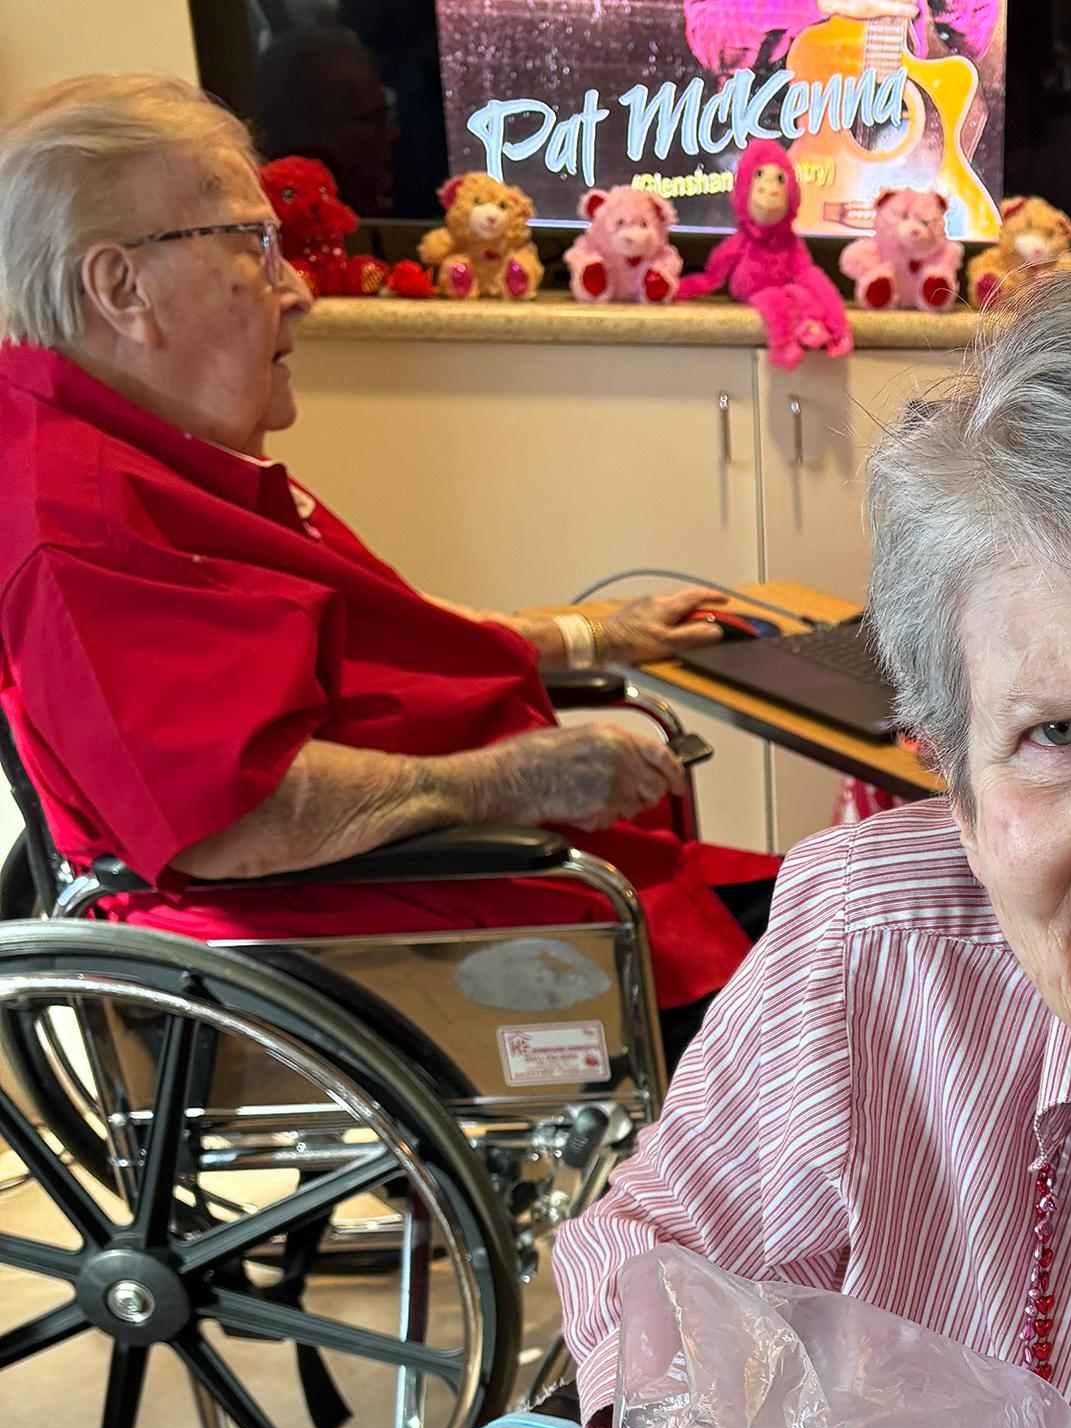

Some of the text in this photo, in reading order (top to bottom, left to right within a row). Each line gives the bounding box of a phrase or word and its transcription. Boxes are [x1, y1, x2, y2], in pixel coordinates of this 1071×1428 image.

[467, 67, 908, 187] Pat McKenna
[631, 168, 734, 199] (Glenshan
